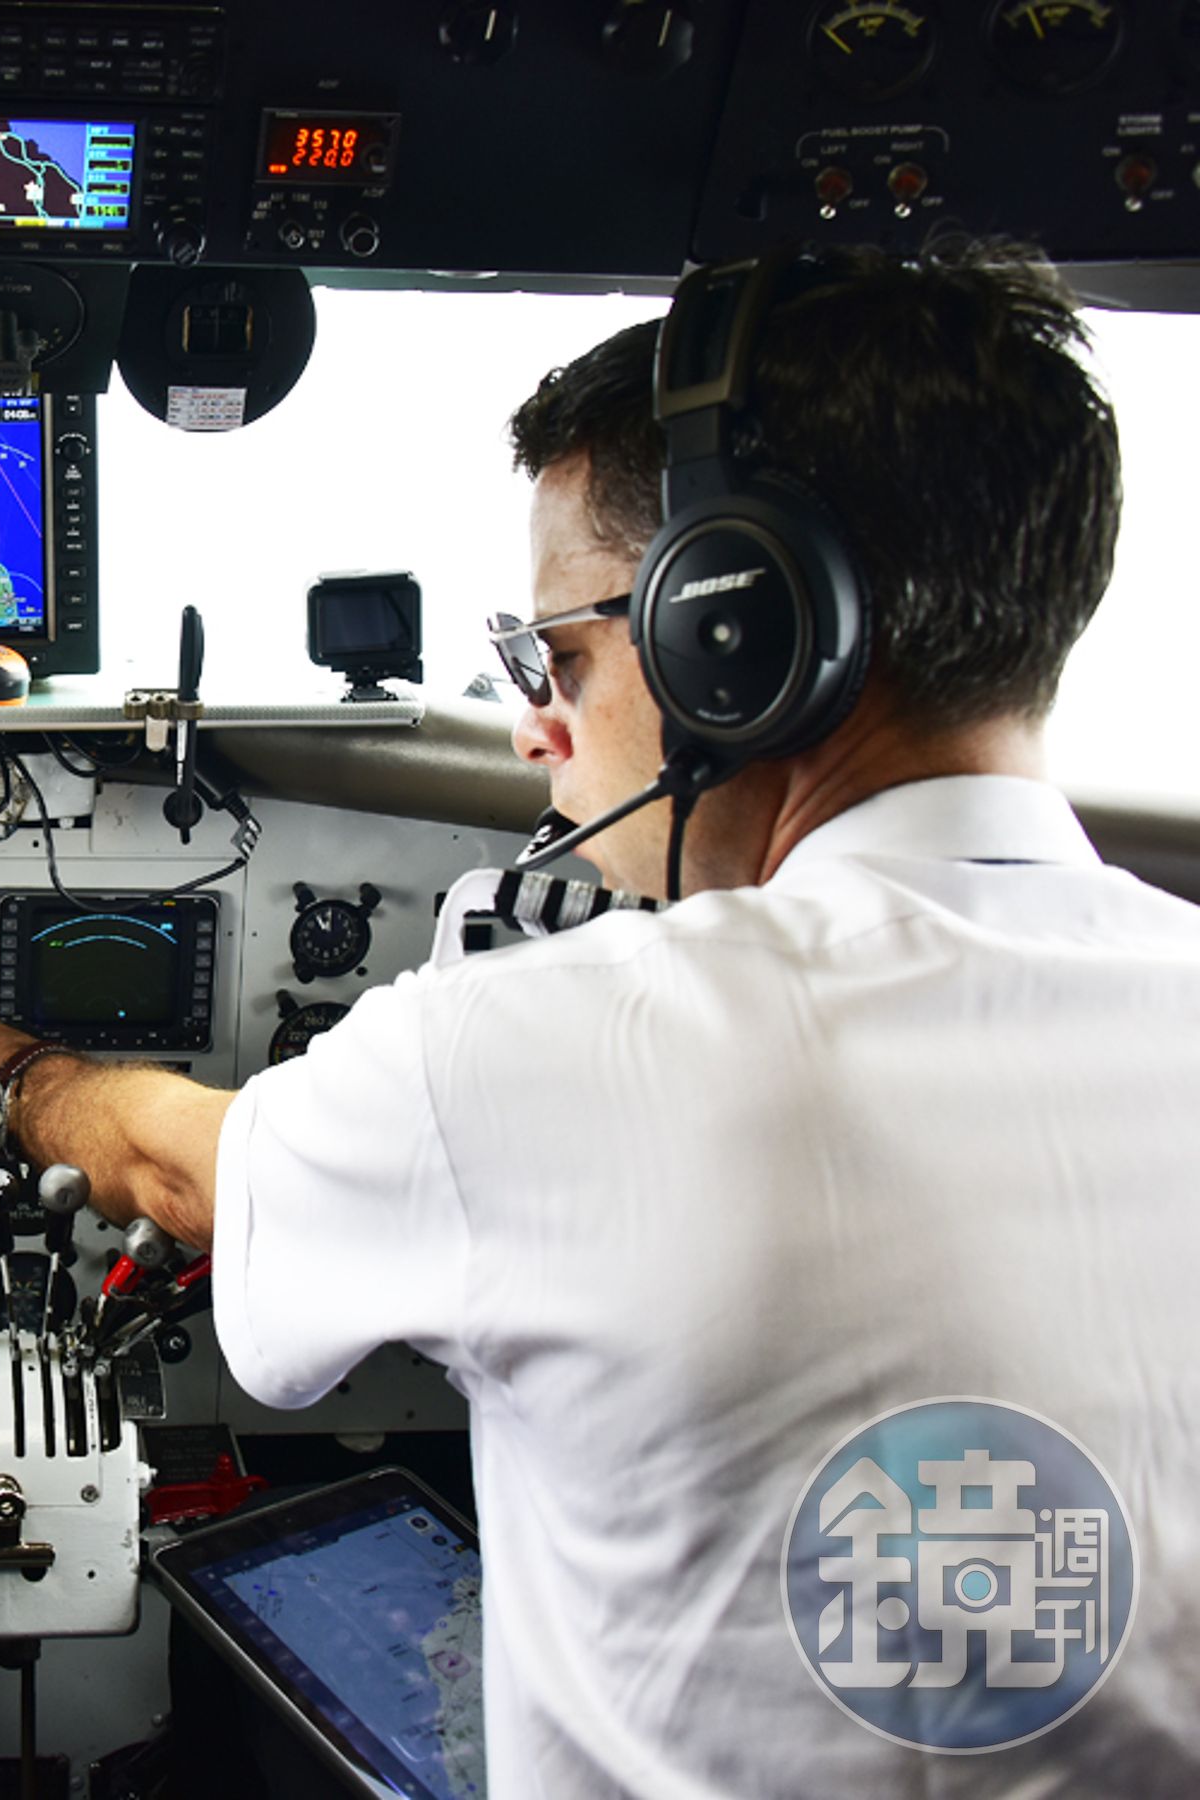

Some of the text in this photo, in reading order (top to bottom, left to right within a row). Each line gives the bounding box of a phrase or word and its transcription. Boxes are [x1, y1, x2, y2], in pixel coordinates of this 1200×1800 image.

[820, 127, 849, 138] FUEL
[890, 124, 923, 136] PUMP
[820, 144, 847, 156] LEFT
[673, 569, 762, 601] BOSE
